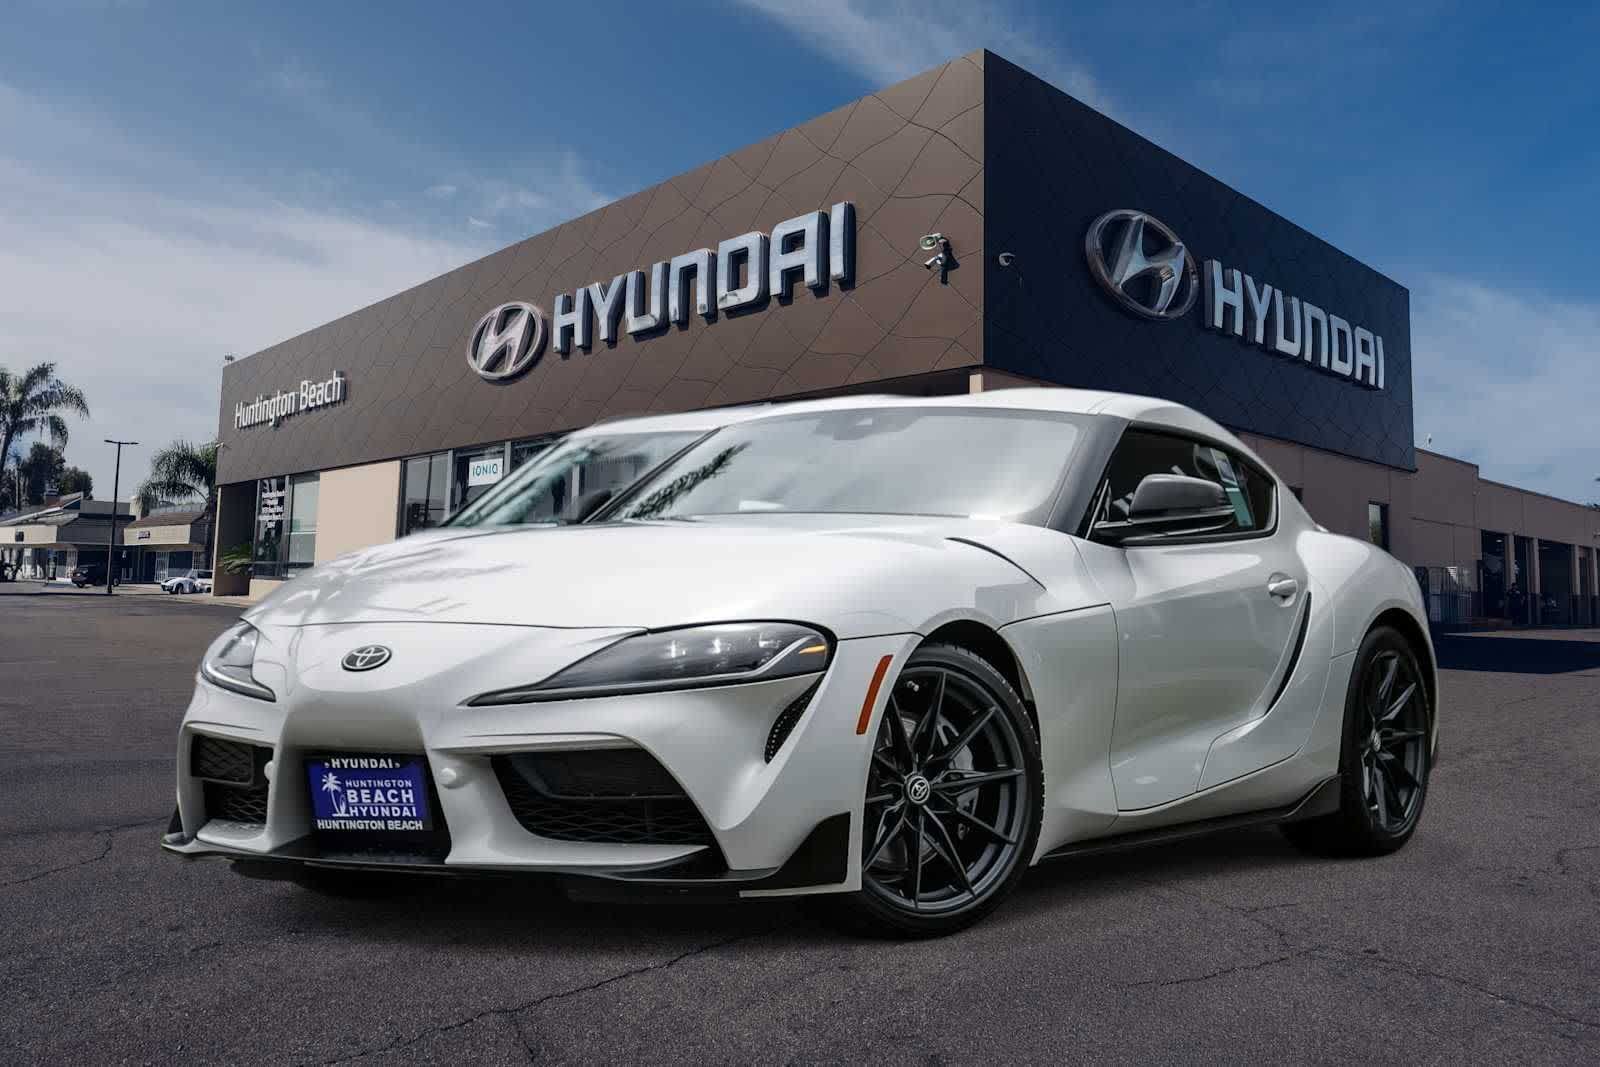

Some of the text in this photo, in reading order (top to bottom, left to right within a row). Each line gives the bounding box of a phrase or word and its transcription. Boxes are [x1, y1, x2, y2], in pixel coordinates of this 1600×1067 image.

[553, 201, 856, 355] HYUNDAI
[1204, 258, 1385, 390] HYUNDAI
[234, 370, 344, 428] Huntington Beach
[331, 758, 393, 769] HYUNDAI
[345, 779, 412, 788] HUNTINGTON
[346, 789, 414, 803] BEACH
[349, 806, 416, 817] HYUNDAI
[317, 820, 423, 831] HUNTINGTON BEACH
